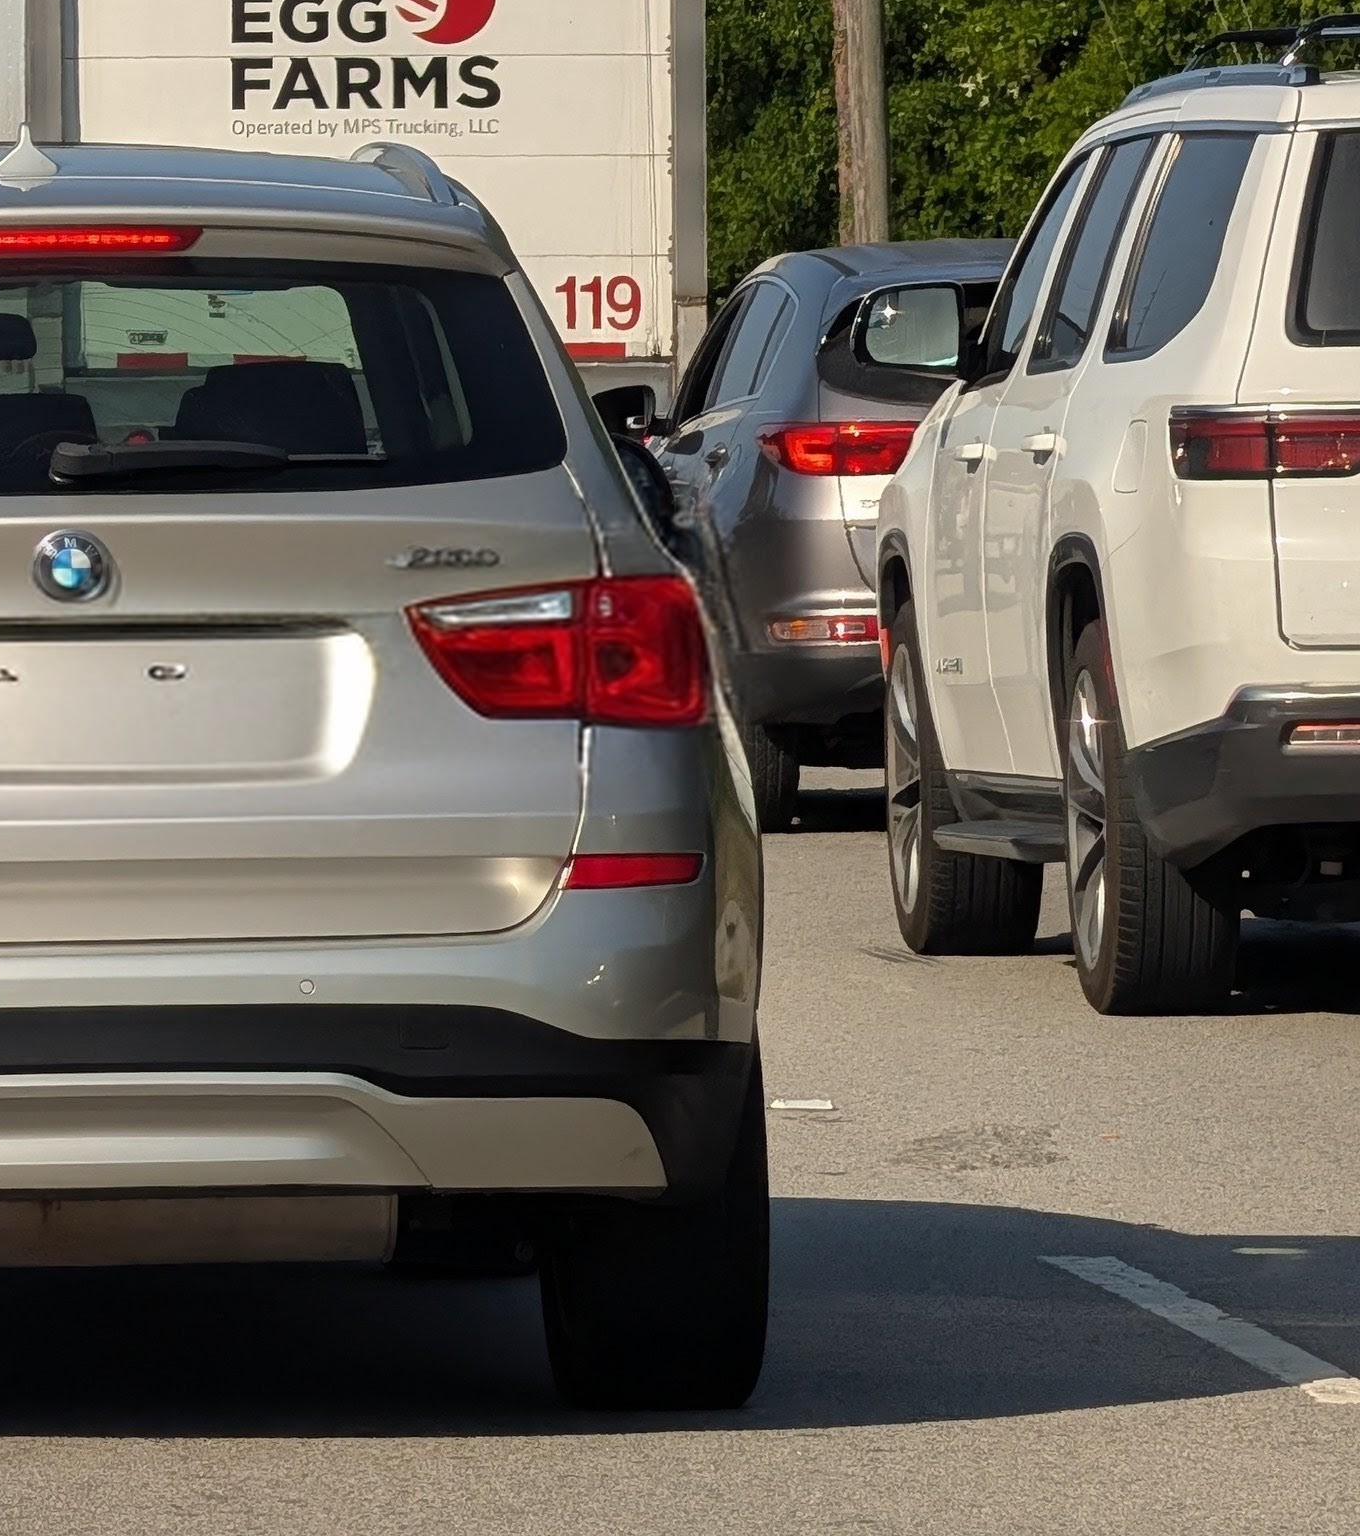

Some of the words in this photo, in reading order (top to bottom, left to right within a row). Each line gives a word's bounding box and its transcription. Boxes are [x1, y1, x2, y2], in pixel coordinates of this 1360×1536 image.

[230, 55, 502, 111] FARMS
[231, 119, 313, 138] Operated
[317, 119, 339, 138] by
[343, 119, 382, 134] MPS
[385, 119, 464, 138] Trucking,
[468, 119, 499, 134] LLC
[555, 275, 642, 331] 119
